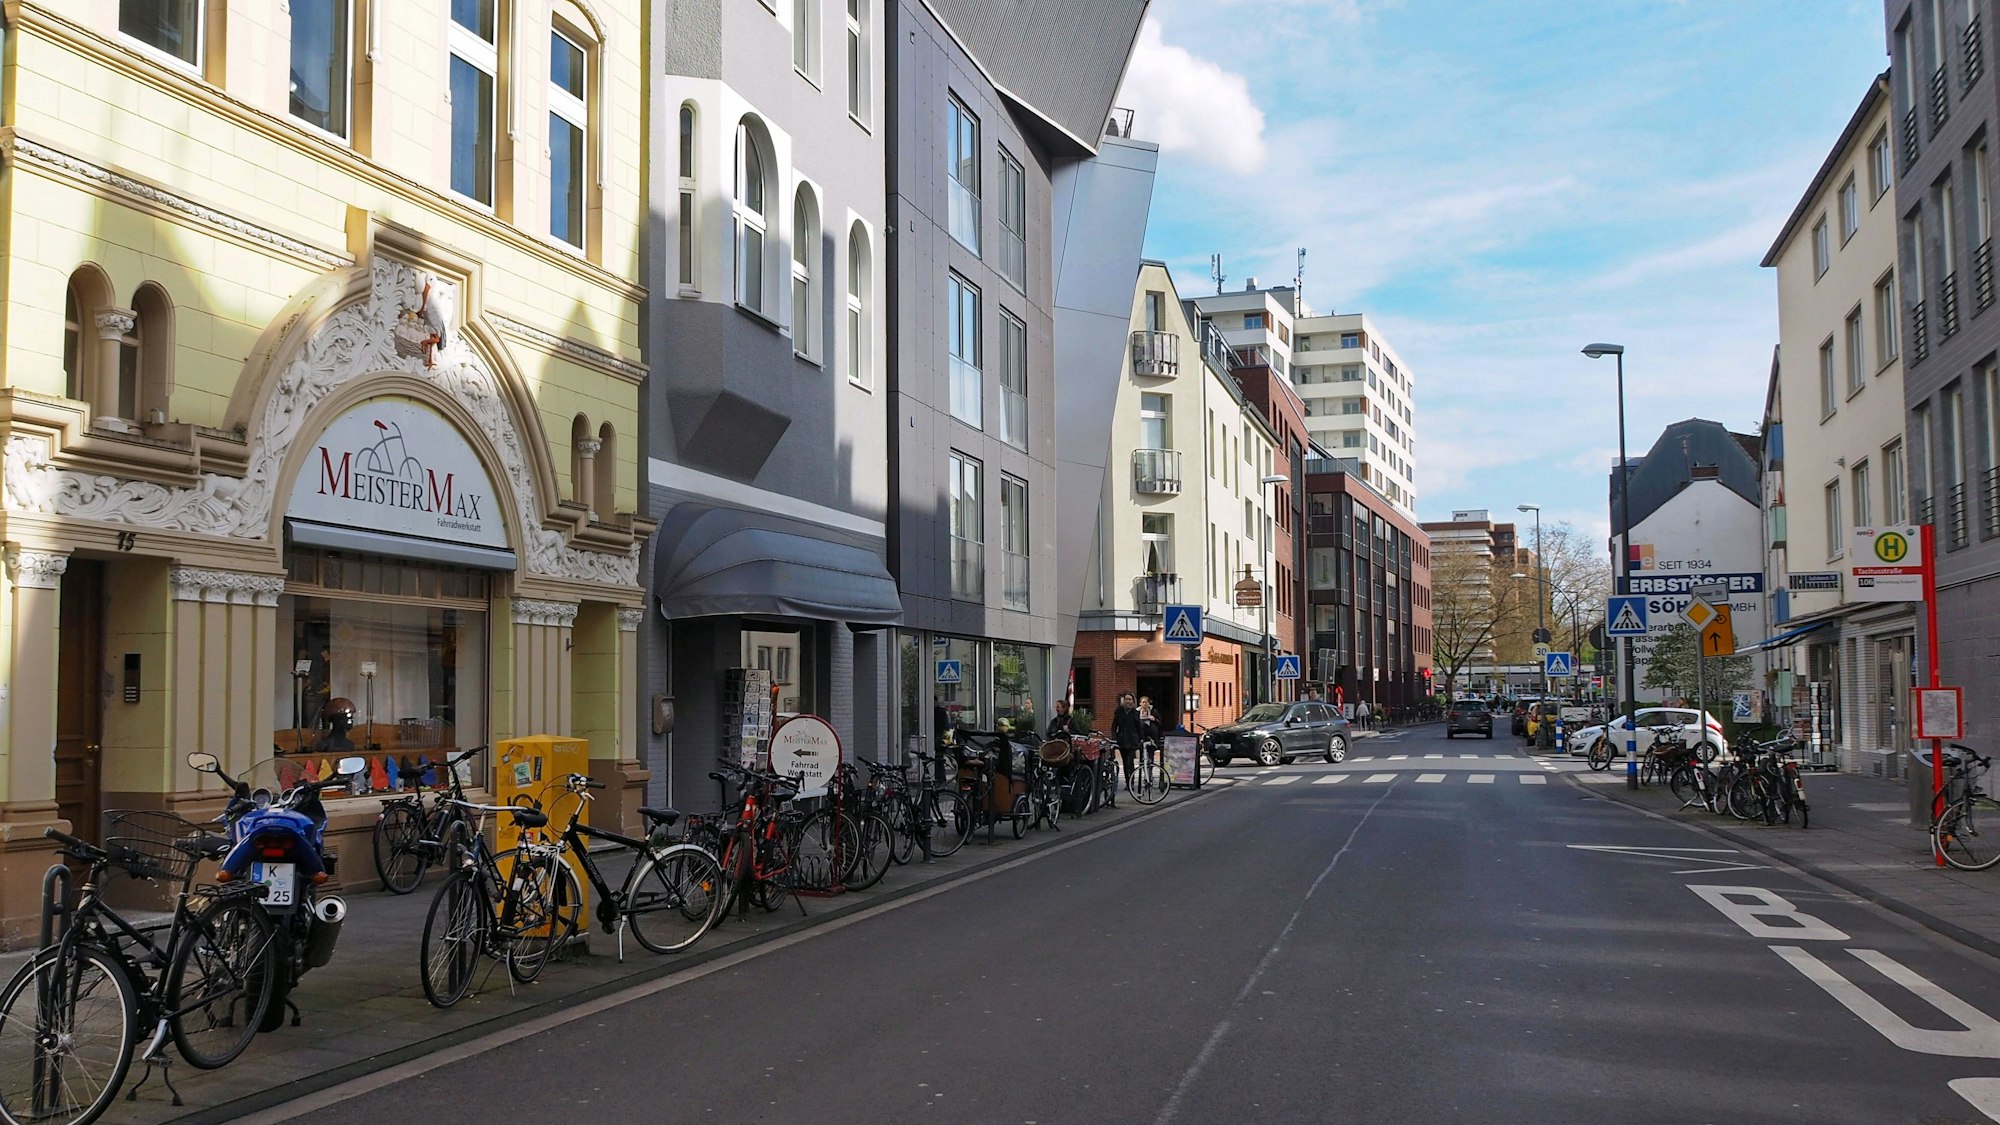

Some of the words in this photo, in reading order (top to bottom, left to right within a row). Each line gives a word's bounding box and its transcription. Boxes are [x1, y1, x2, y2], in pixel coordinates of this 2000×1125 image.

[437, 517, 482, 533] Fahrradwerkstatt
[1884, 538, 1899, 557] H
[1659, 560, 1683, 570] SEIT
[1686, 559, 1712, 569] 1934
[1536, 647, 1547, 656] 30
[791, 760, 819, 769] Fahrrad
[269, 865, 277, 877] K
[273, 890, 290, 902] 25
